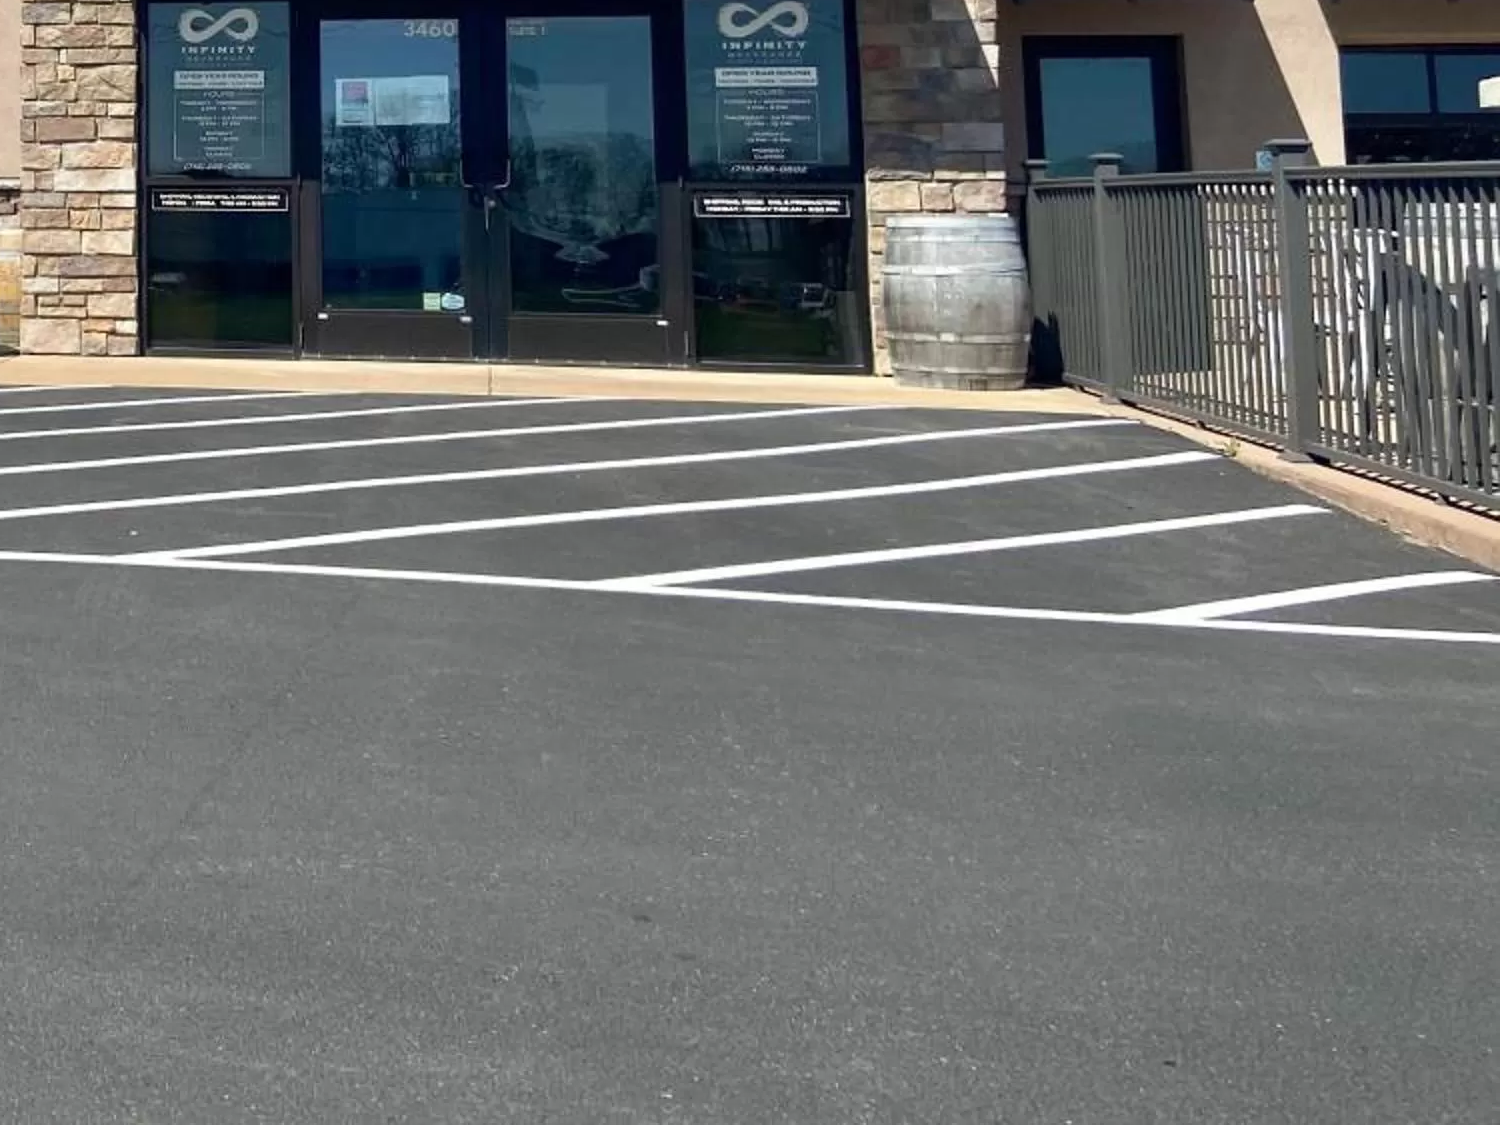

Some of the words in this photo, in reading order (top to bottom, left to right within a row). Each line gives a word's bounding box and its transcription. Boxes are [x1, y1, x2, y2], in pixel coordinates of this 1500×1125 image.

[403, 20, 457, 37] 3460
[181, 46, 256, 54] INFINITY
[721, 41, 807, 50] INFINITY
